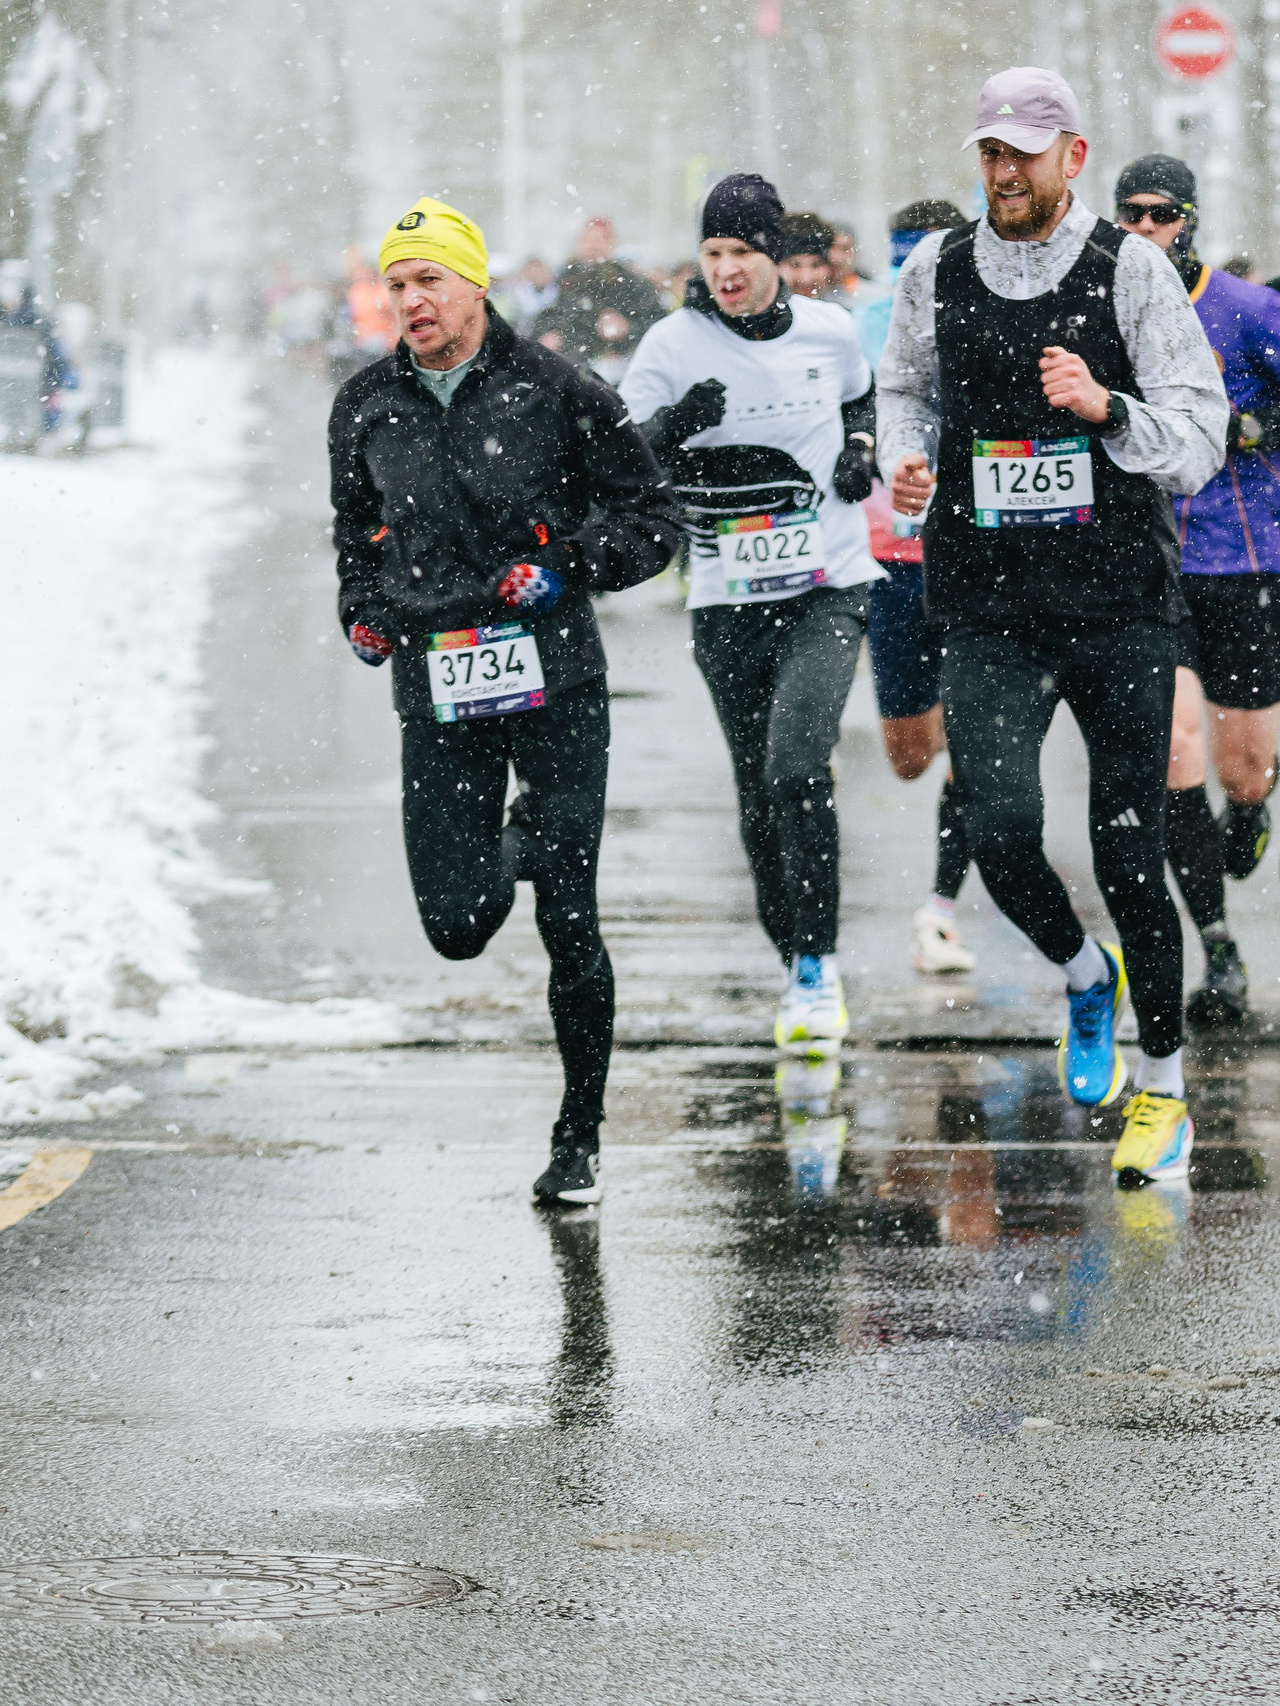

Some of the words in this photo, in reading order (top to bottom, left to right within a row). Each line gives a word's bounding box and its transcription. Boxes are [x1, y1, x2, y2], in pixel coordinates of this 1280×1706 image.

[988, 459, 1075, 493] 1265
[1006, 494, 1057, 506] АЛЕКСЕЙ
[735, 529, 812, 563] 4022
[439, 644, 525, 687] 3734
